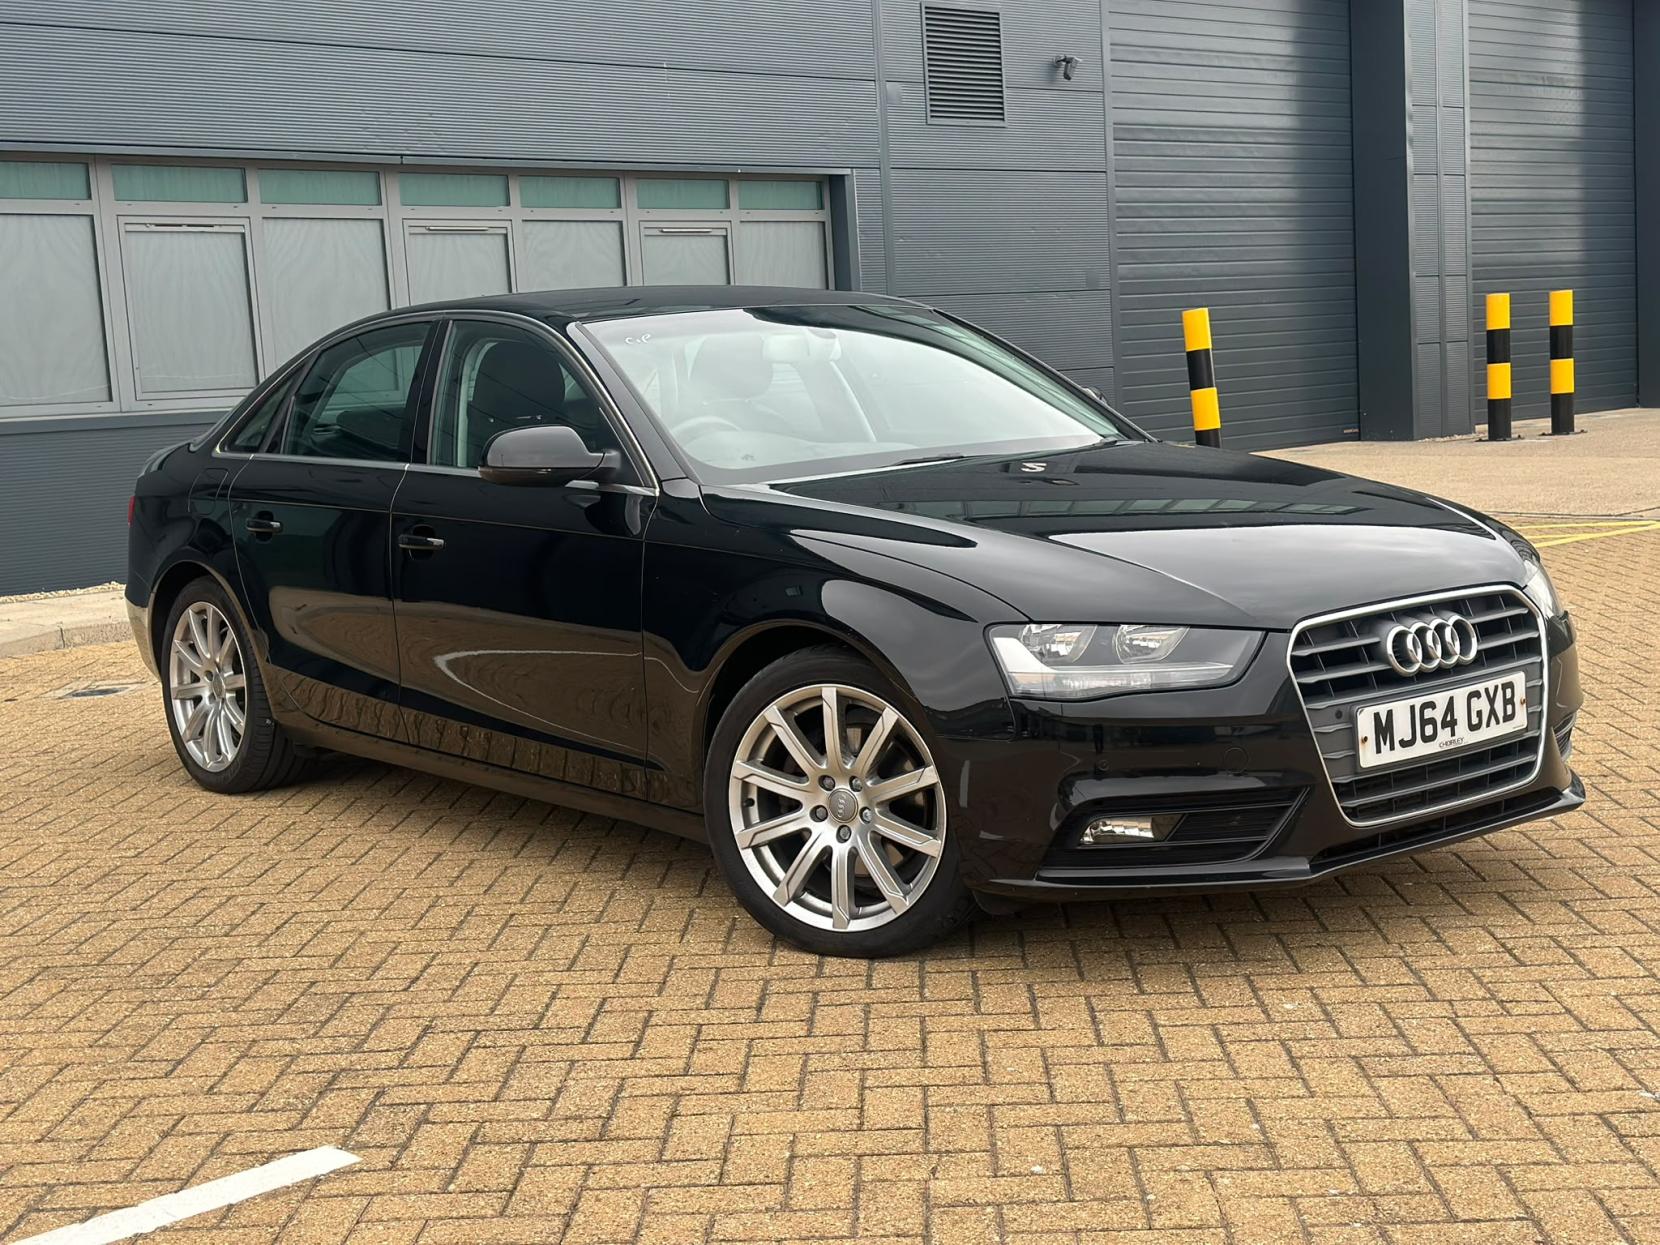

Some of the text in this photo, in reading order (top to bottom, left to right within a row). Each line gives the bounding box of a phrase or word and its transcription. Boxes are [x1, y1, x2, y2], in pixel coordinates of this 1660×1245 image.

[1373, 680, 1516, 754] MJ64 GXB
[1439, 737, 1464, 748] CHORLEY
